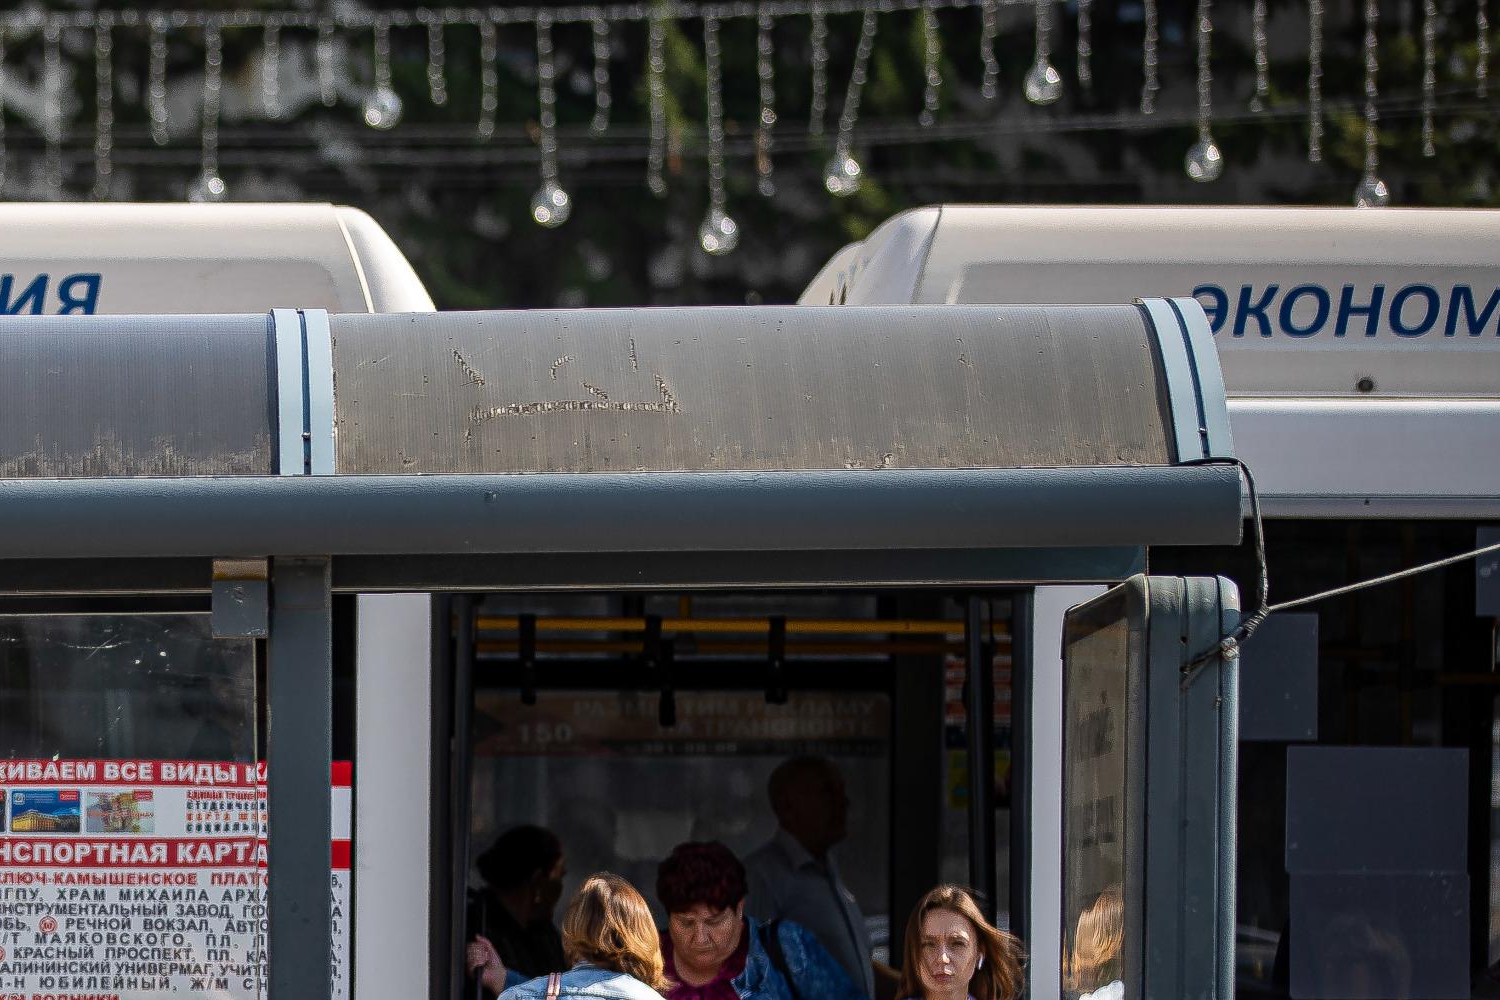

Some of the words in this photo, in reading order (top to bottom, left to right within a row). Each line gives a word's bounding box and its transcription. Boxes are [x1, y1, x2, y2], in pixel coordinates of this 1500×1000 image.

[1192, 282, 1500, 339] ЭКОНОМ
[103, 761, 154, 782] ВСЕ
[161, 763, 238, 784] ВИДЫ
[56, 888, 107, 901] ХРАМ
[118, 888, 210, 902] МИХАИЛА
[242, 903, 268, 917] ГО
[65, 915, 132, 930] РЕЧНОЙ
[143, 918, 214, 934] ВОКЗАЛ,
[13, 944, 94, 959] КРАСНЫЙ
[105, 946, 196, 962] ПРОСПЕКТ,
[39, 973, 178, 993] ЮБИЛЕЙНЫЙ,
